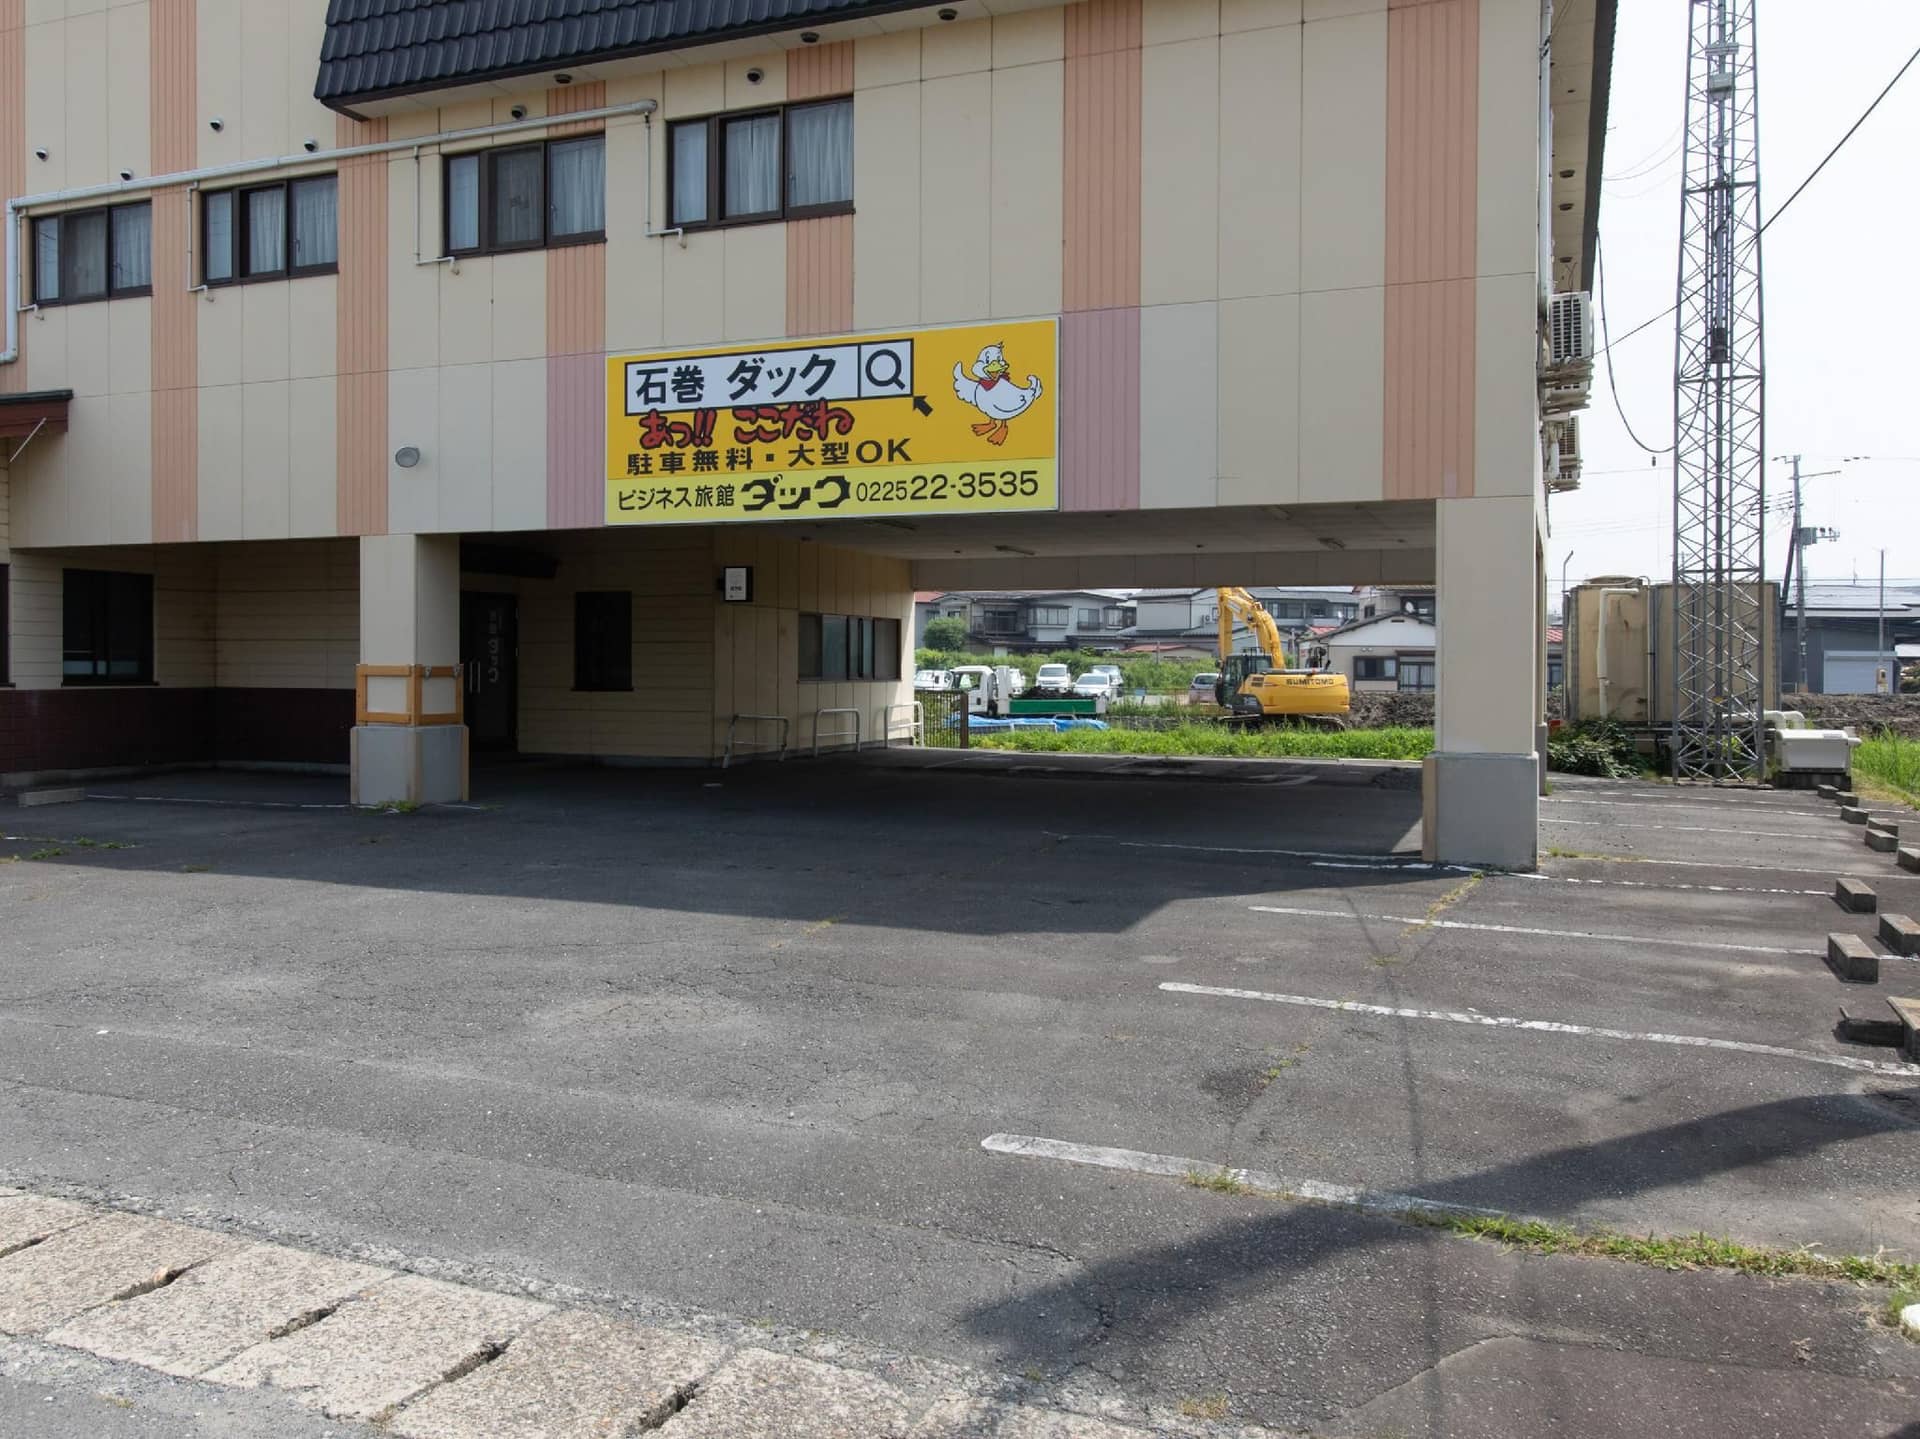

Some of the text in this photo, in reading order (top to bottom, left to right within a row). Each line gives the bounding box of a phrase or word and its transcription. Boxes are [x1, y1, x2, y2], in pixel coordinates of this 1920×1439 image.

[636, 353, 837, 406] 石巻 ダック
